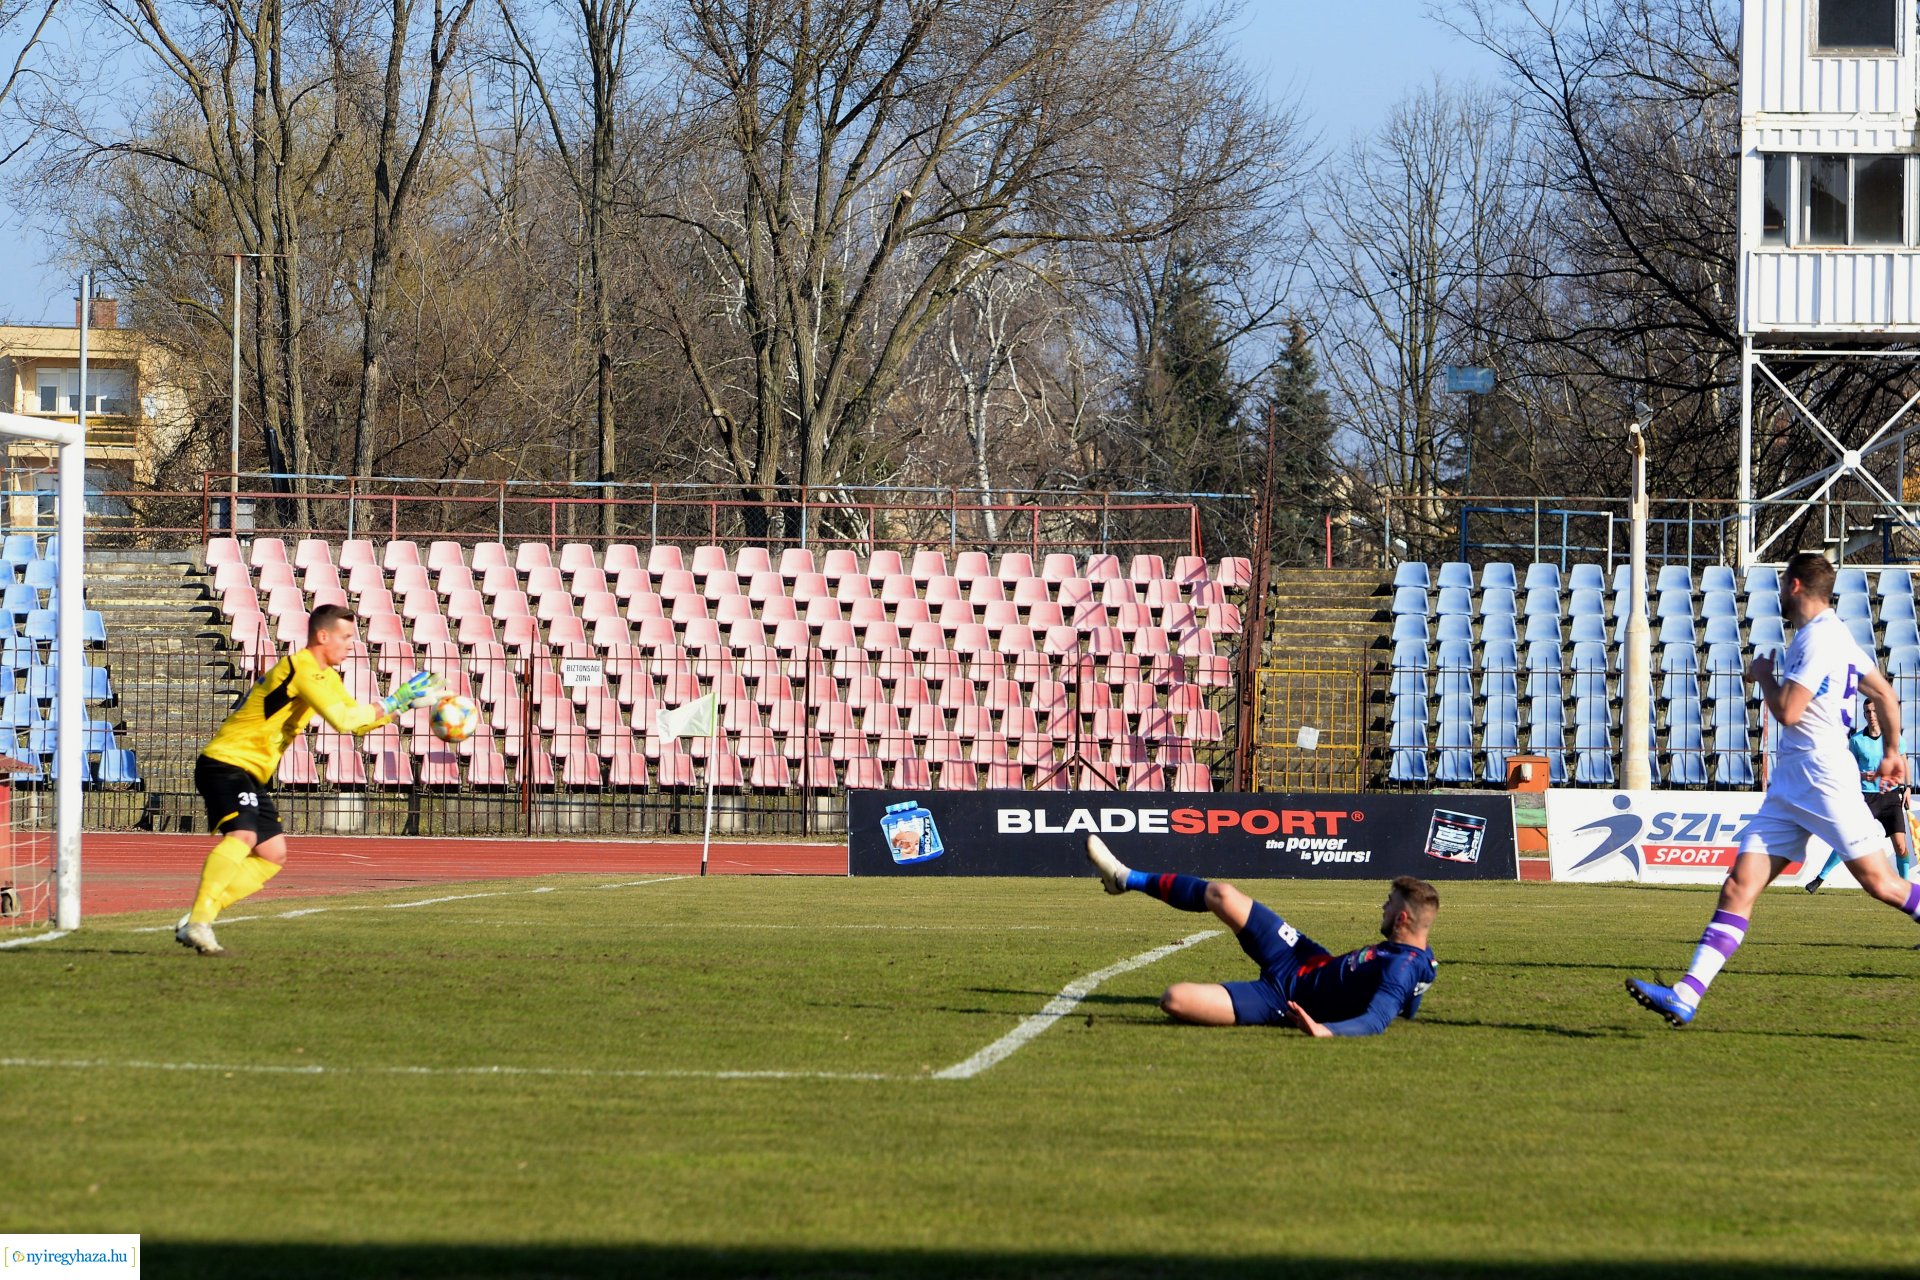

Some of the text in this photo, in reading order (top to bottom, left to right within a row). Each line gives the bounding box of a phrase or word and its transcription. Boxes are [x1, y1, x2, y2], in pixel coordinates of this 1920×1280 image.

[237, 791, 259, 807] 35
[1265, 837, 1347, 852] the power
[1311, 850, 1371, 866] yours!
[1653, 847, 1725, 864] SPORT
